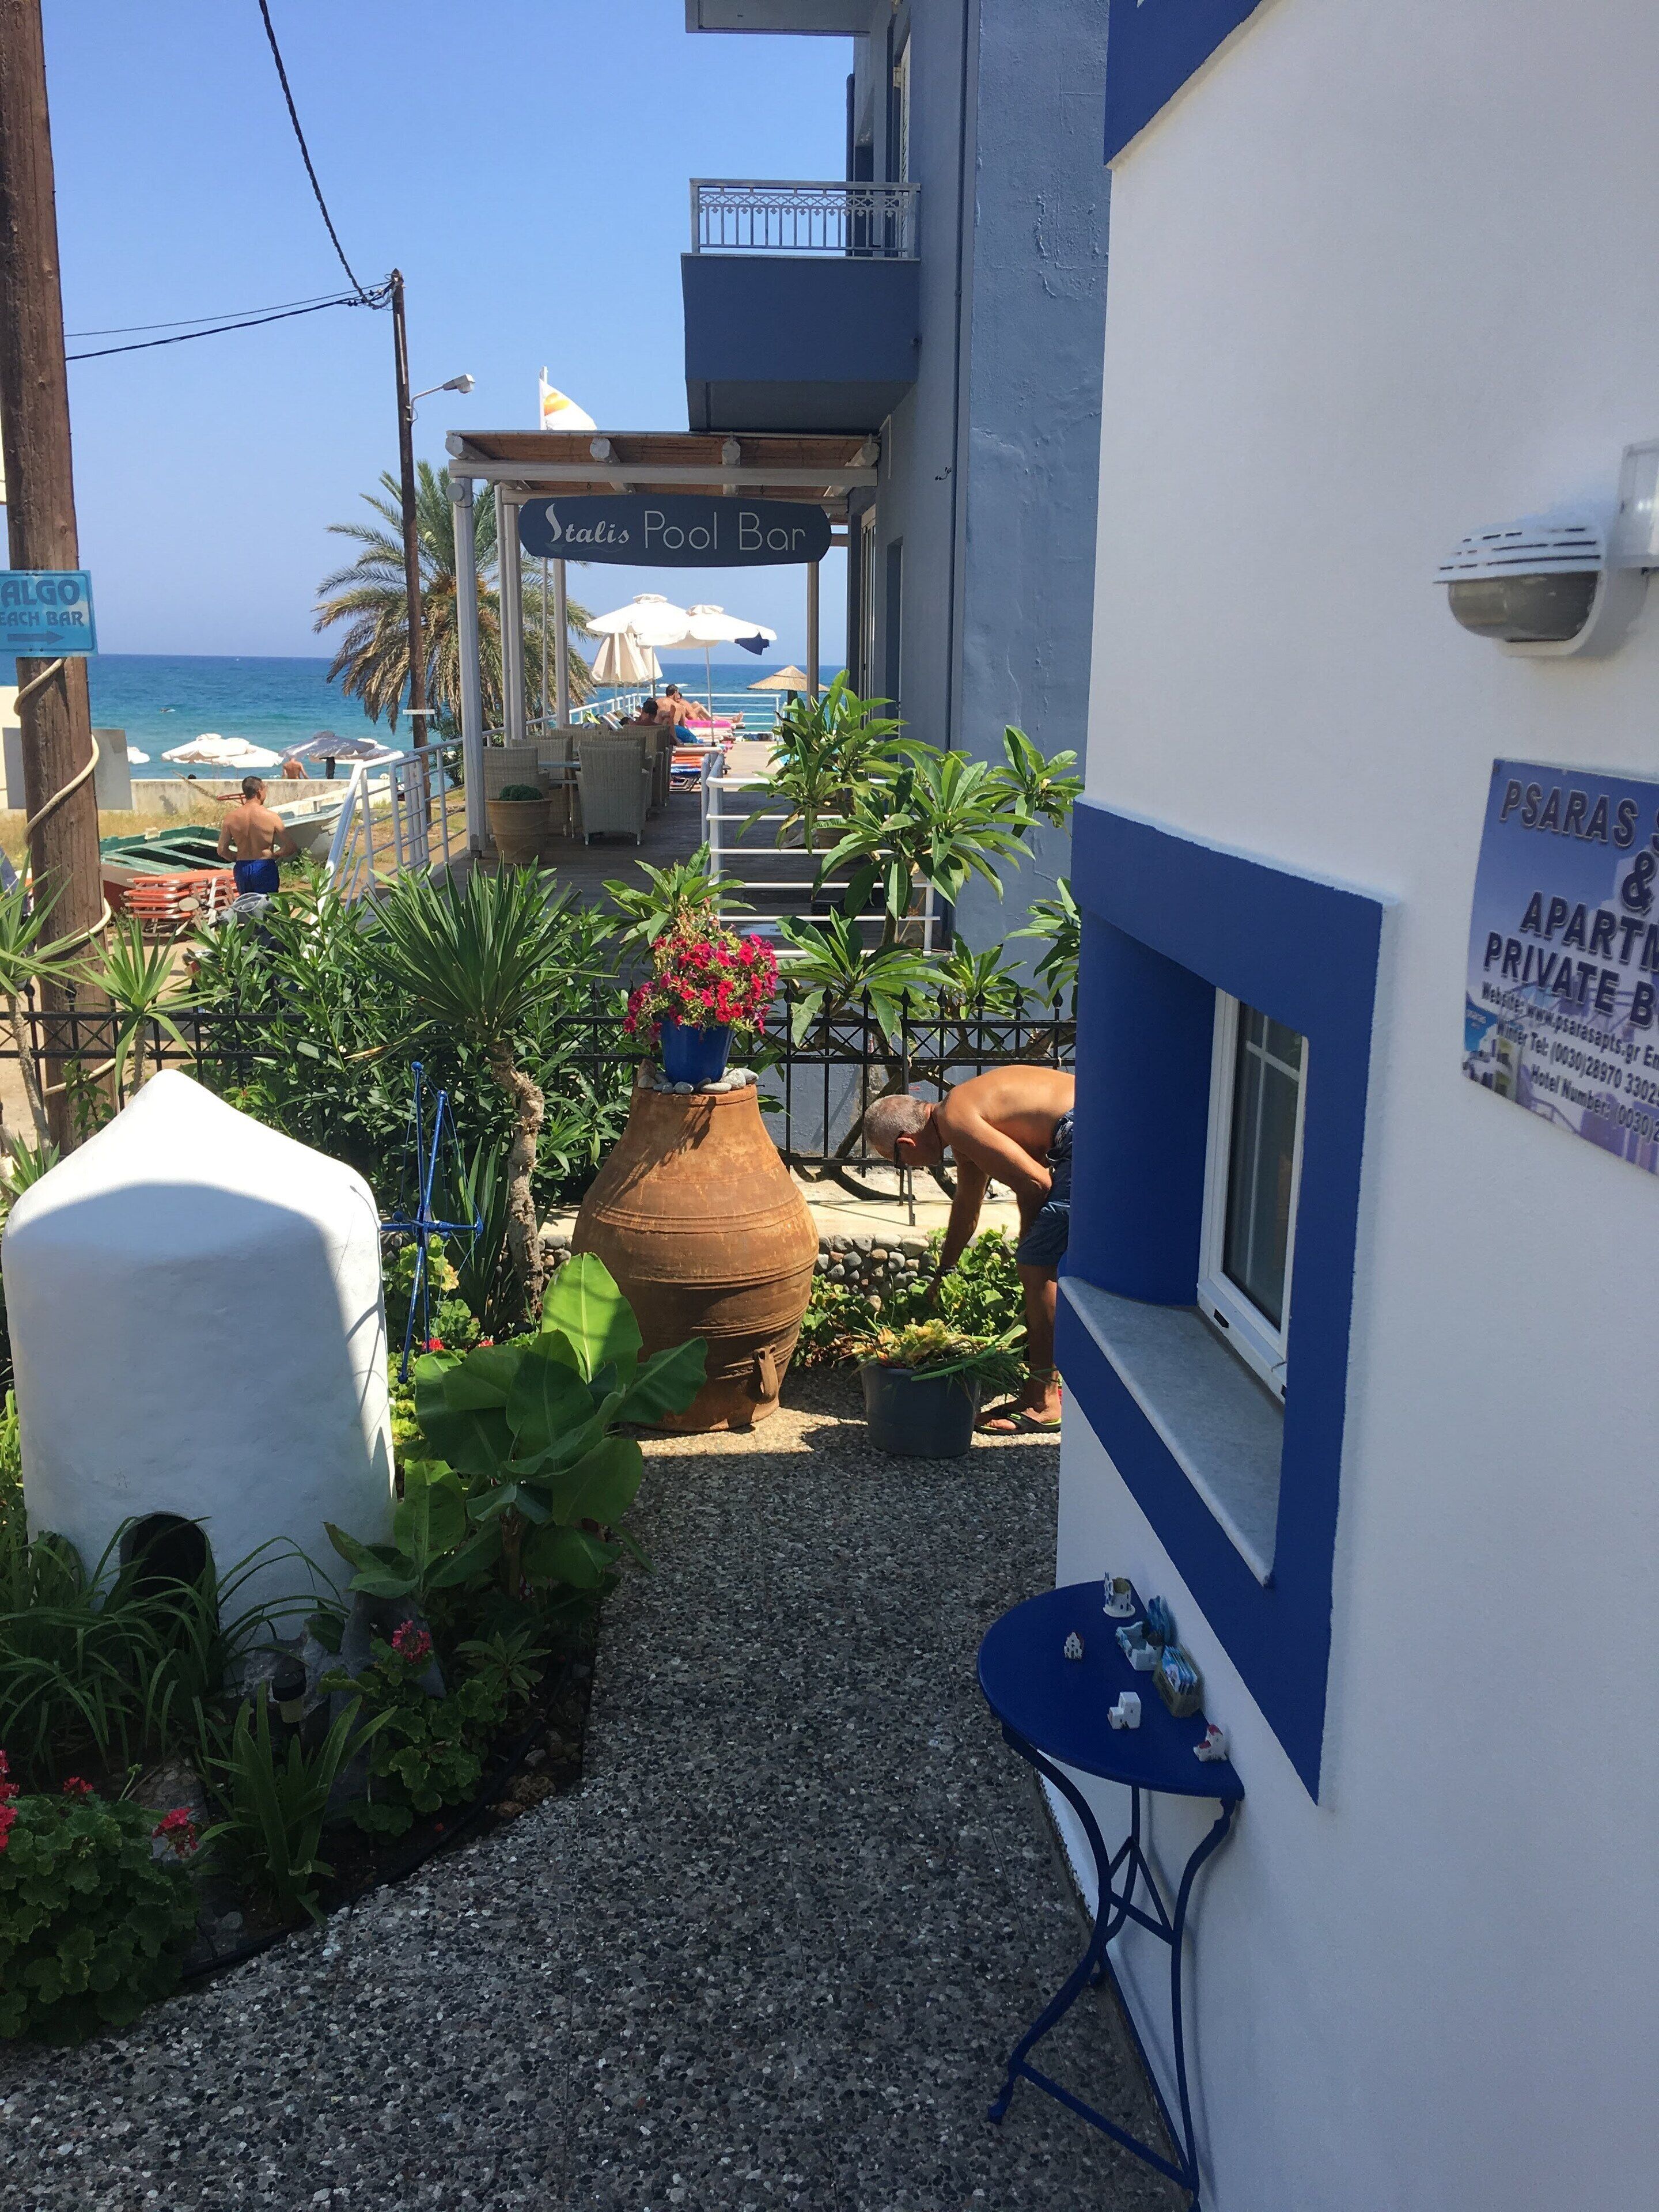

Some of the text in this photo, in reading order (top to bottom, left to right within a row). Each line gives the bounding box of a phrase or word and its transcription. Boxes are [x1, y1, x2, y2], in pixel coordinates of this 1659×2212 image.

[545, 503, 806, 551] Stalis Pool Bar
[46, 611, 85, 627] BAR
[1499, 779, 1638, 848] PSARAS
[1621, 850, 1657, 915] &
[1483, 931, 1659, 1031] PRIVATE B
[1624, 1073, 1659, 1107] 3302
